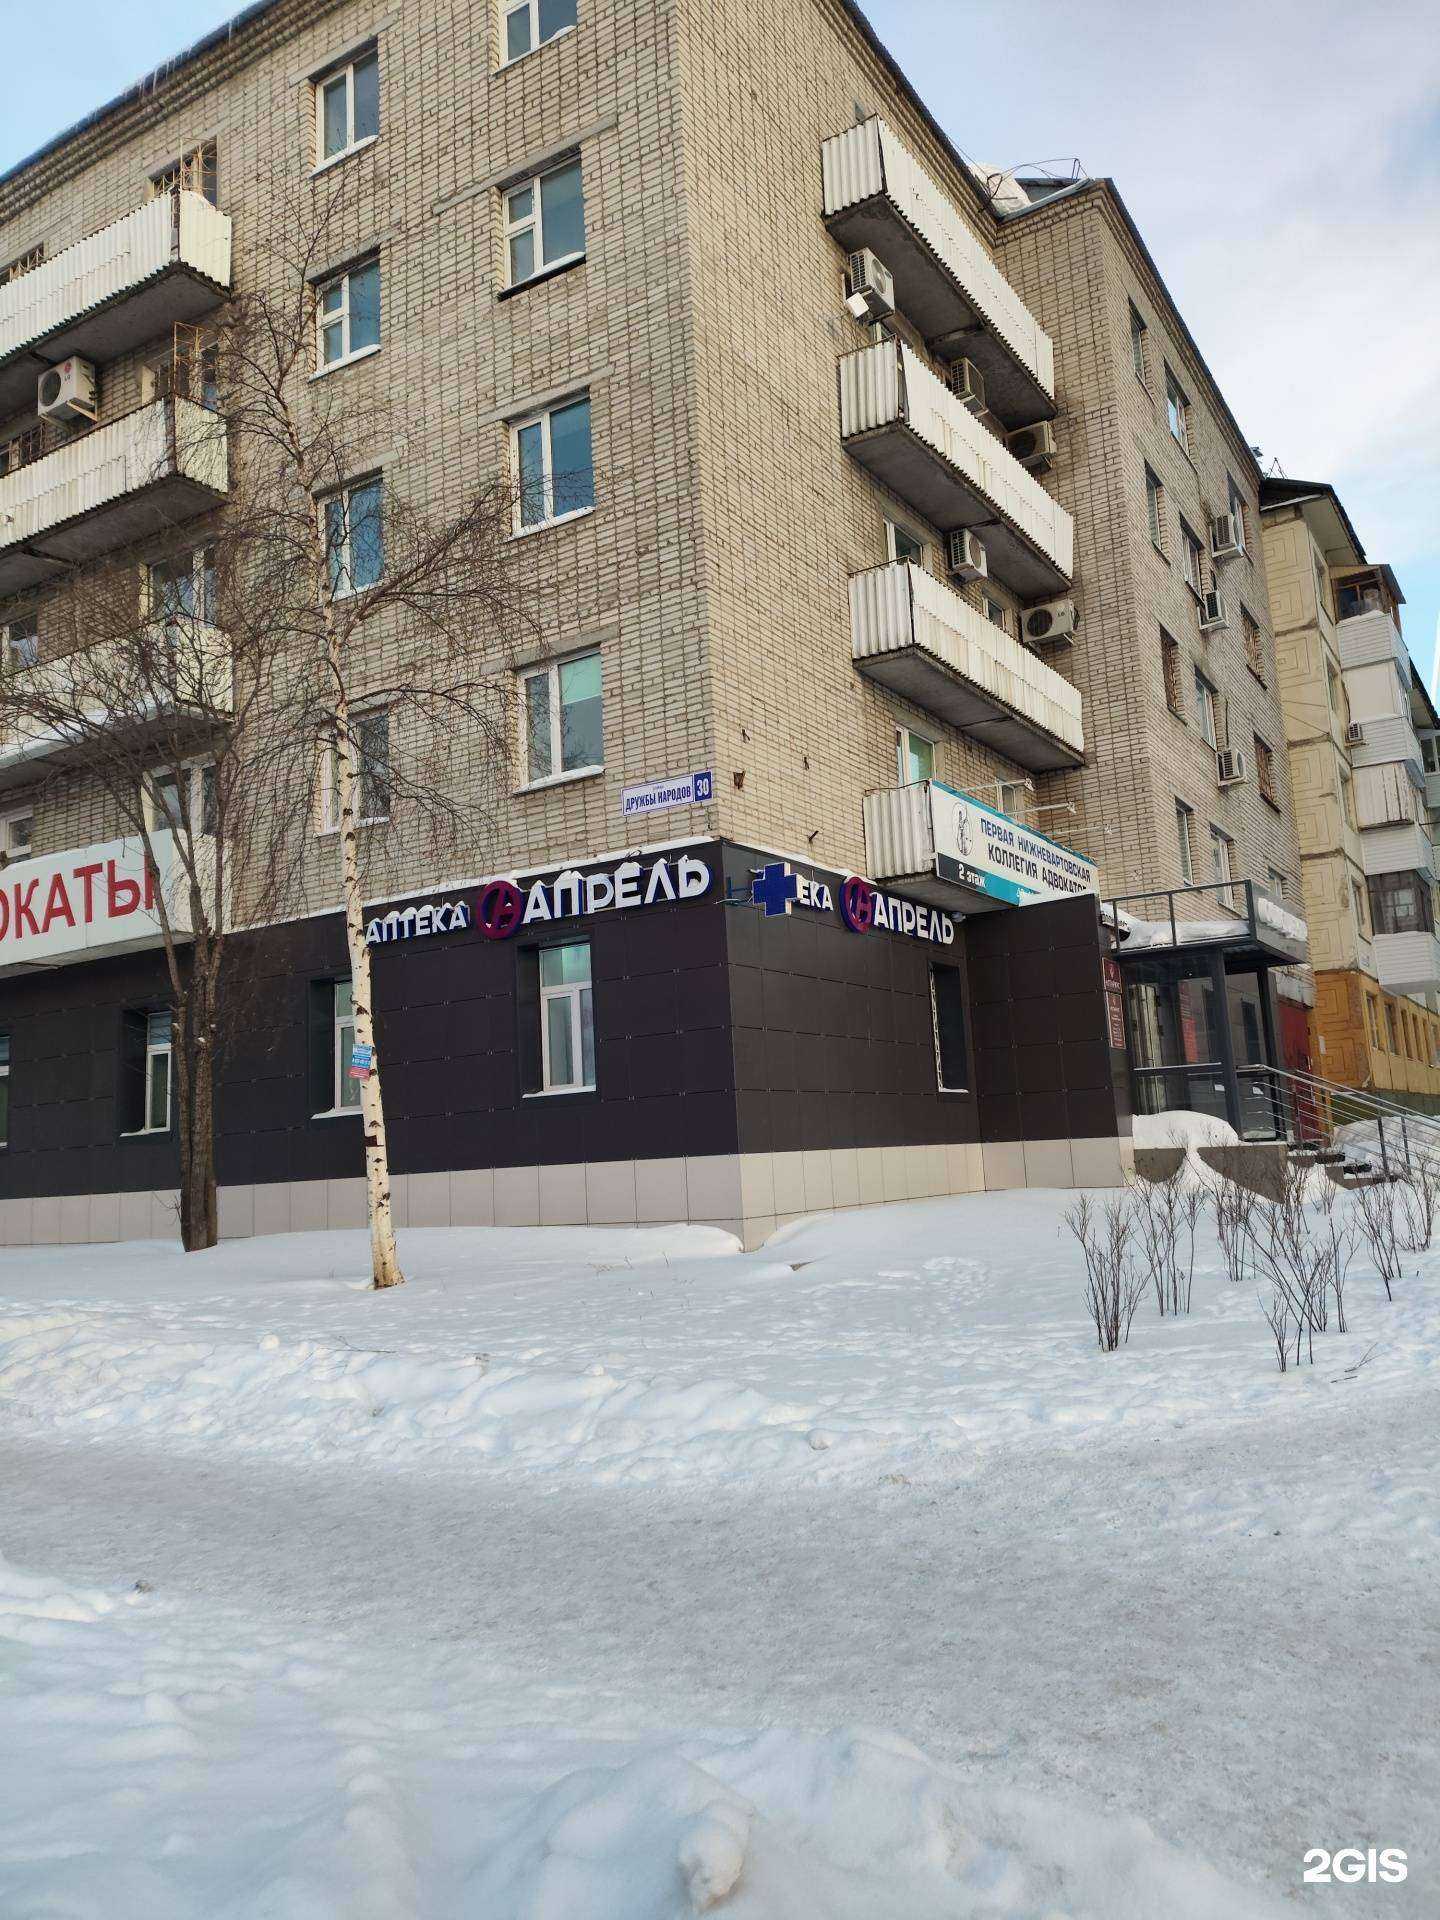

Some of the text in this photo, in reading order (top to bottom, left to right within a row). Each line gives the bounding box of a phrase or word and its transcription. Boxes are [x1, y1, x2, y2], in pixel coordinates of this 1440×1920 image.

[625, 778, 710, 812] ДРУЖБЫ НАРОДОВ 30
[980, 817, 1091, 883] ПЕРВАЯ НИЖНЕВАРТОВСКАЯ
[987, 843, 1087, 894] КОЛЛЕГИЯ АДВОКАТО
[365, 857, 712, 944] АПТЕКА АПРЕЛЬ
[872, 892, 955, 945] АПРЕЛЬ
